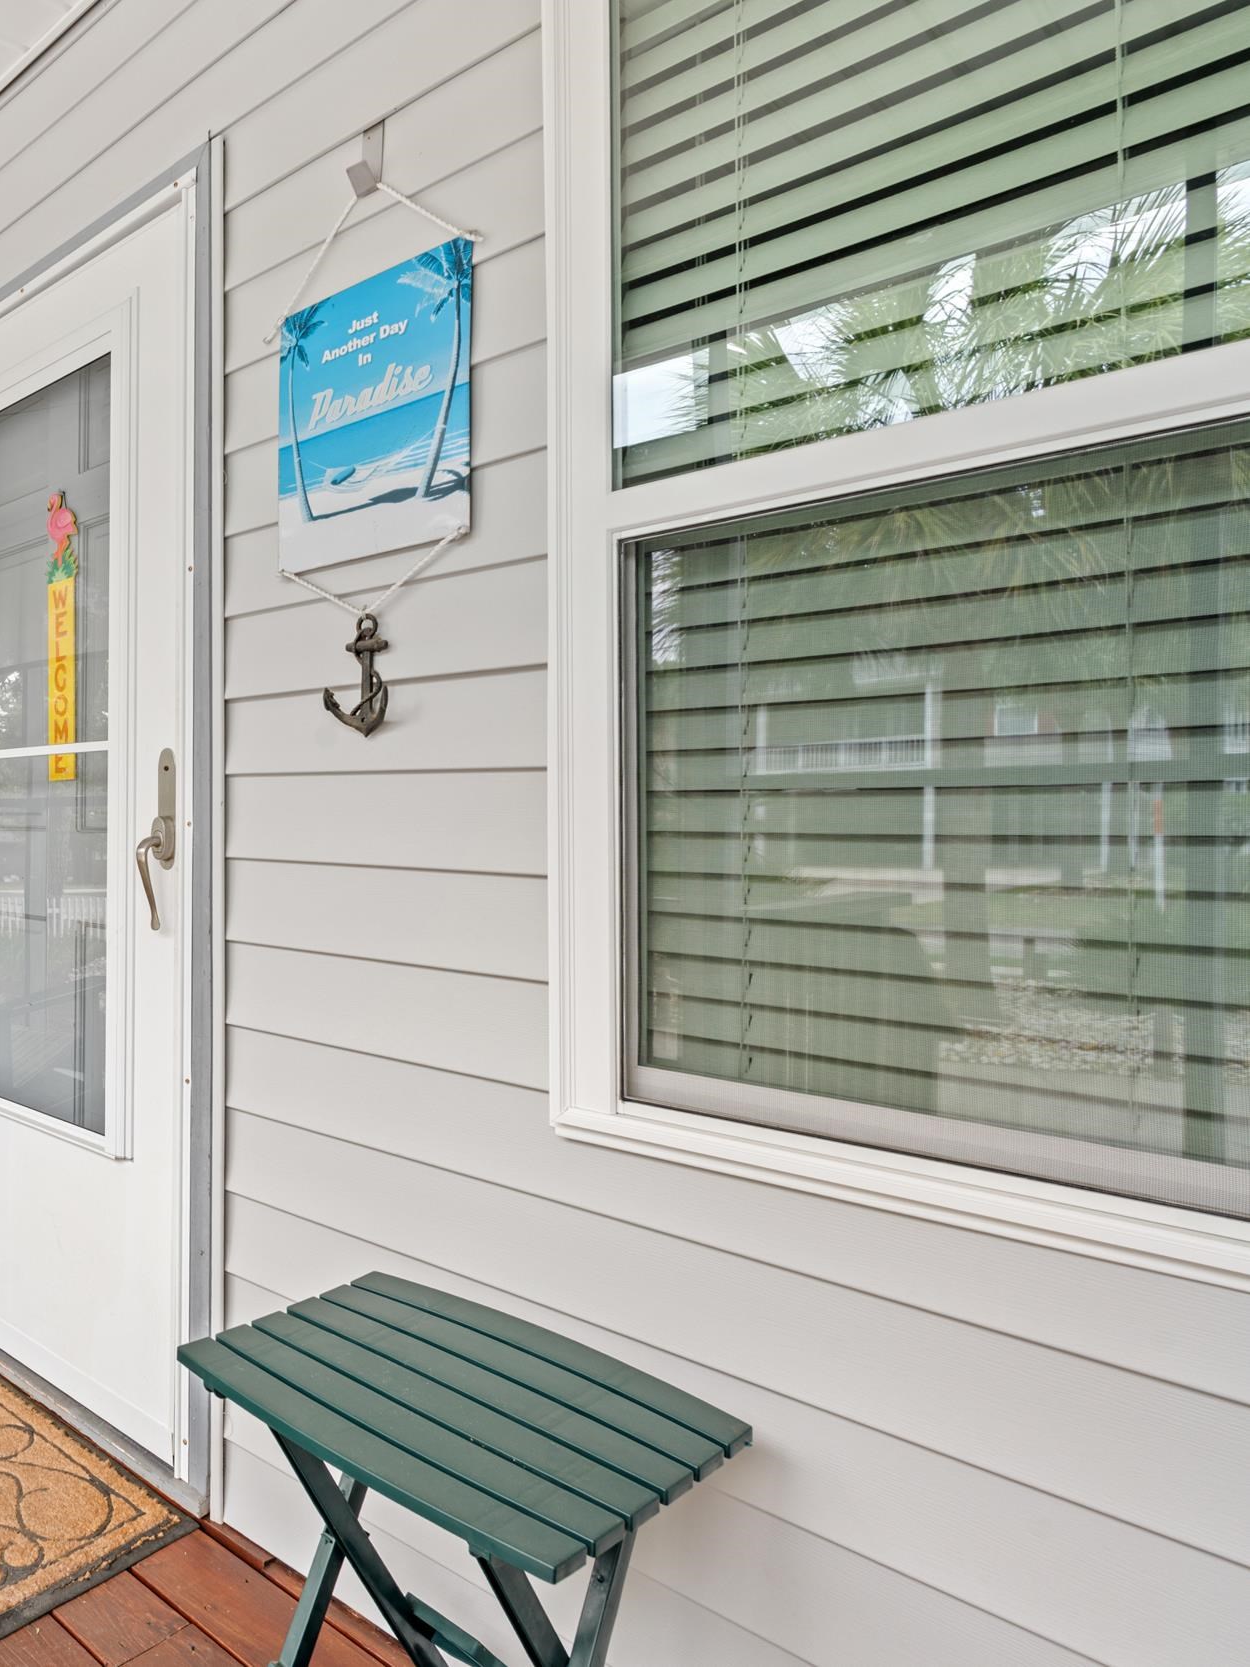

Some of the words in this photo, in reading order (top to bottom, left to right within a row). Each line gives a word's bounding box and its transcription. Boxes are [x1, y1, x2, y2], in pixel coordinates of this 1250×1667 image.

[321, 331, 376, 364] Another
[379, 319, 409, 340] Day
[347, 311, 379, 334] Just
[357, 351, 372, 367] In
[308, 362, 434, 431] Paradise
[52, 585, 70, 775] WELCOME
